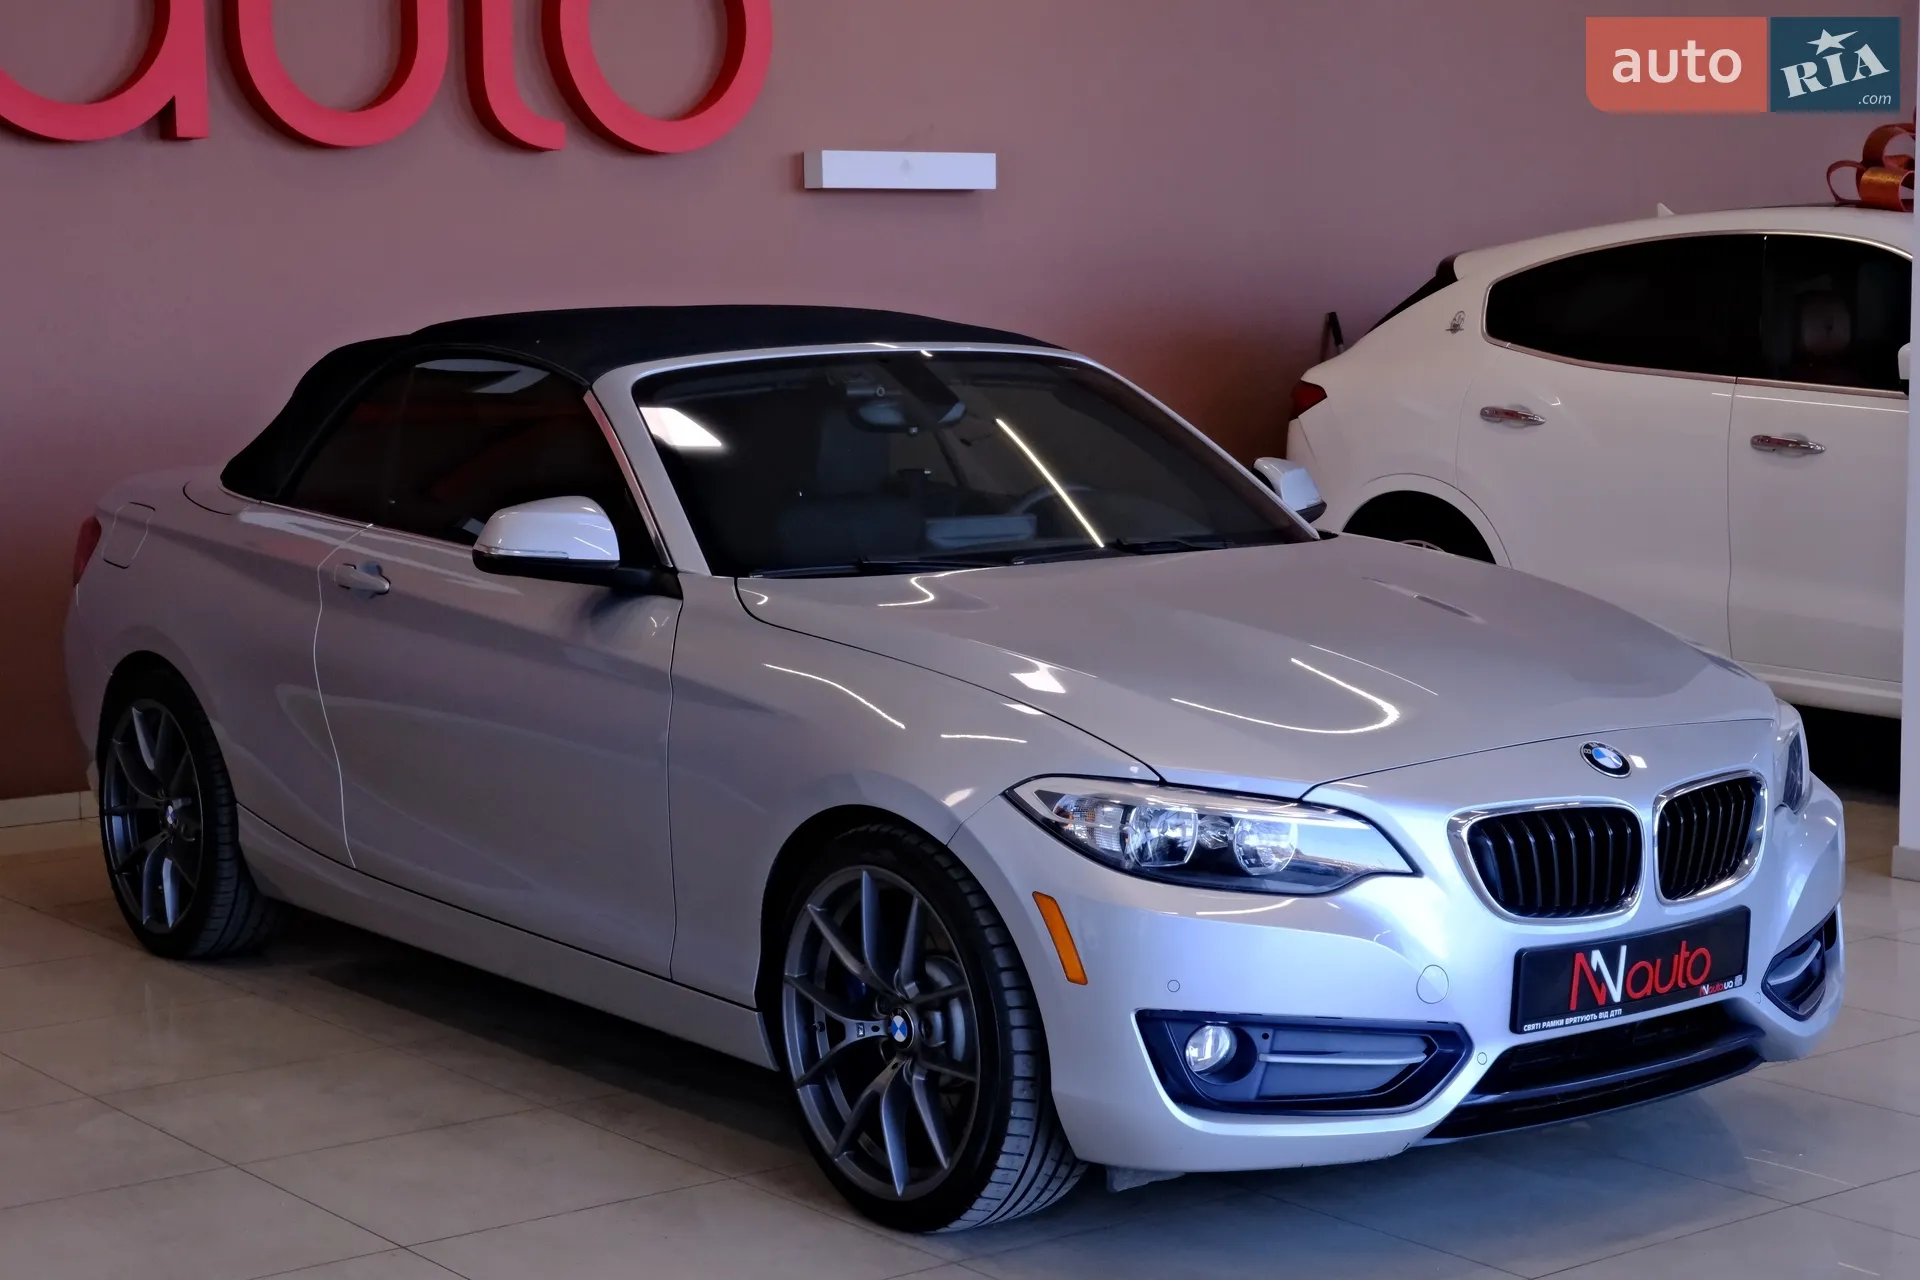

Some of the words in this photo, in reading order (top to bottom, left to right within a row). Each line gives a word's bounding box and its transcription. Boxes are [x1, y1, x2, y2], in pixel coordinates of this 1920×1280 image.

[1523, 1022, 1541, 1032] СВЯТІ
[1542, 1019, 1564, 1029] РАМКИ
[1565, 1013, 1598, 1025] ВРЯТУЮТЬ
[1598, 1011, 1609, 1019] ВІД
[1610, 1008, 1622, 1018] ДТП
